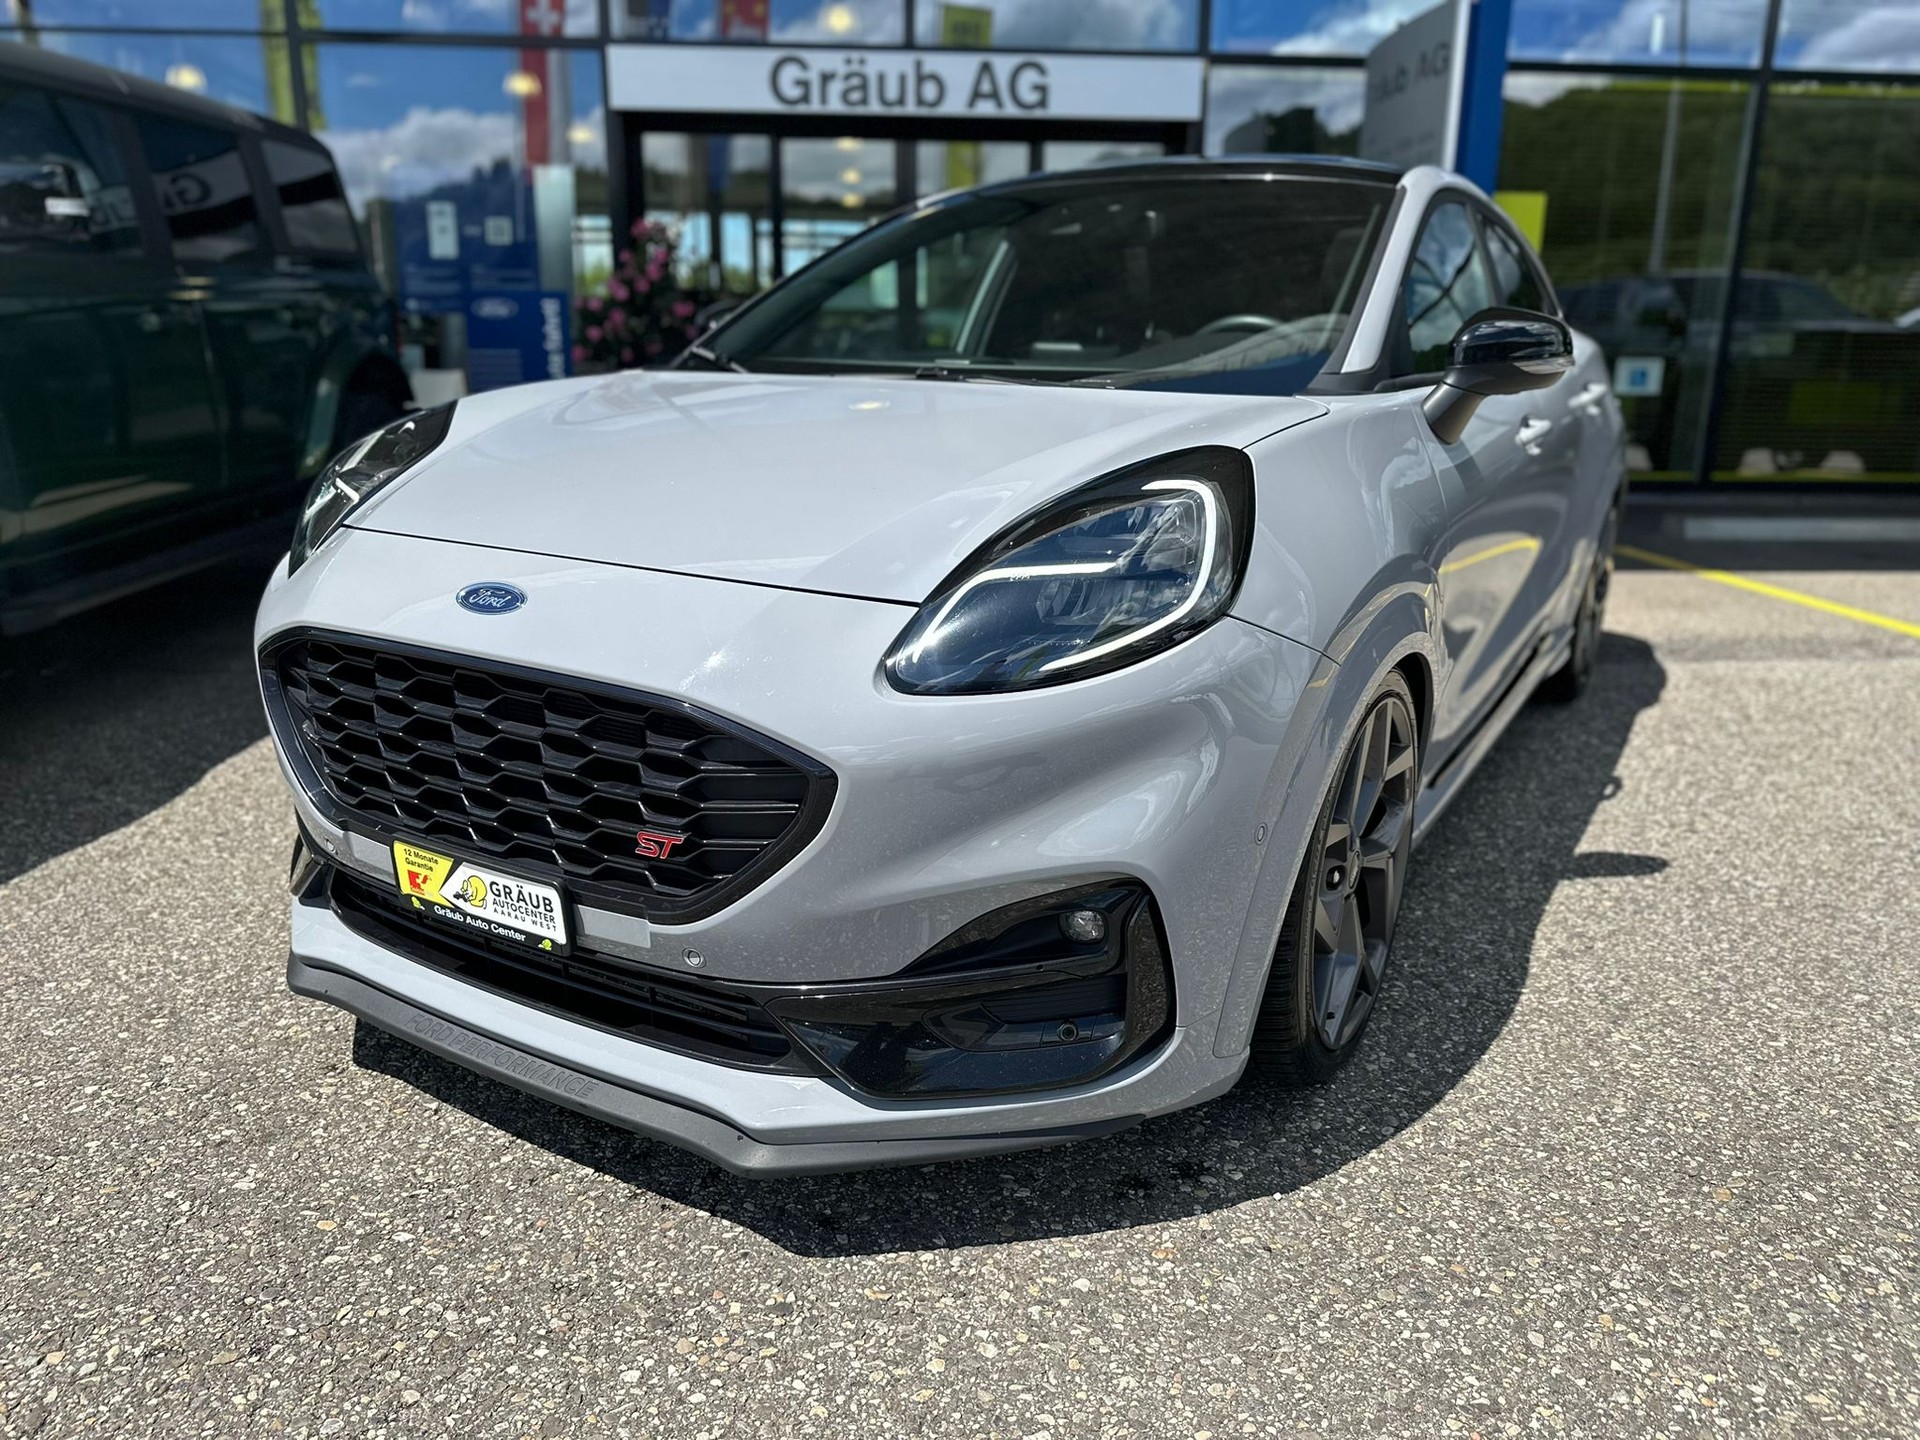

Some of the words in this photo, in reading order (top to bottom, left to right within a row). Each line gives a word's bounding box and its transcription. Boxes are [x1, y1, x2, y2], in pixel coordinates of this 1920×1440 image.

[769, 55, 947, 109] Gräub
[966, 59, 1050, 111] AG
[404, 848, 412, 857] 12
[413, 850, 439, 865] Monate
[635, 831, 684, 859] ST
[405, 857, 434, 872] Garantie
[489, 881, 554, 913] GRÄUB
[433, 905, 464, 922] Gräub
[466, 915, 489, 930] Auto
[490, 923, 526, 942] Center
[493, 898, 556, 925] AUTOCENTER
[493, 907, 526, 923] AARAU
[530, 919, 557, 932] WEST
[402, 1013, 455, 1042] FORD
[449, 1030, 599, 1099] PERFORMANCE
